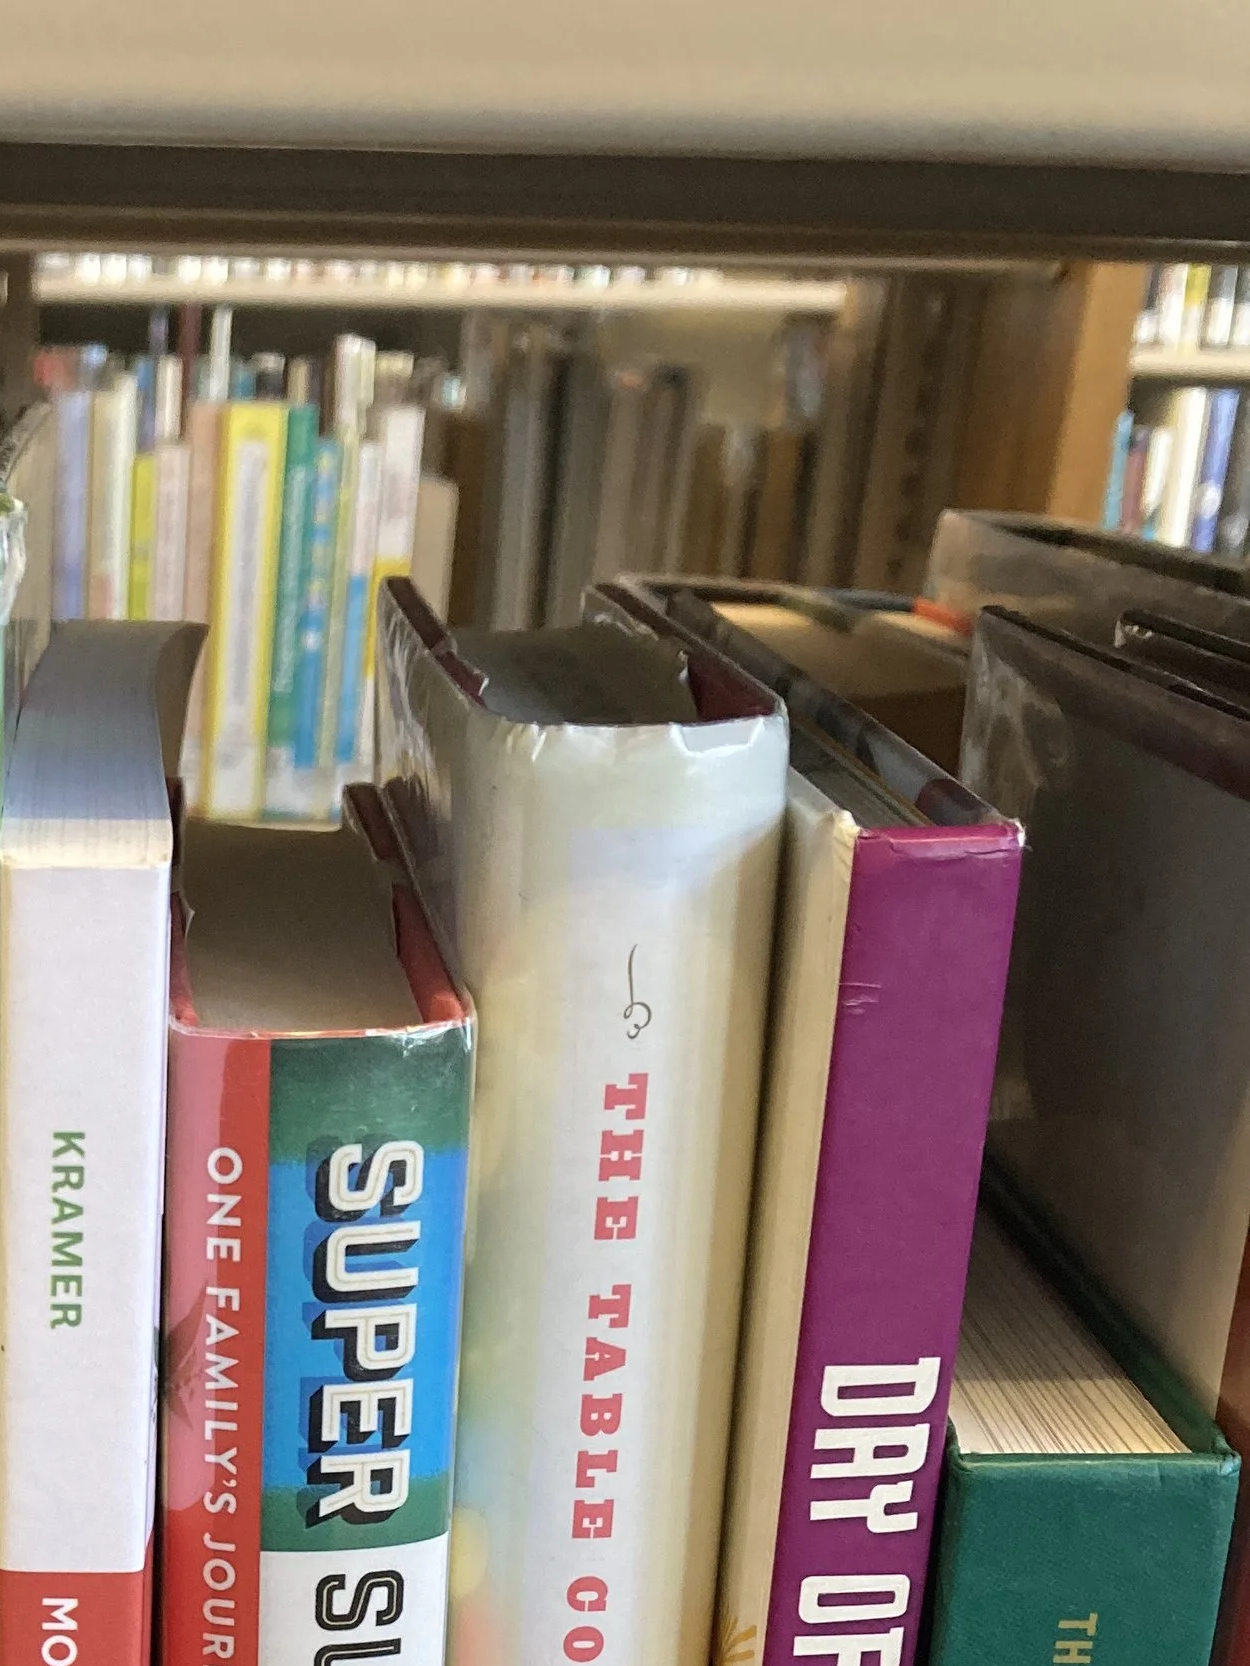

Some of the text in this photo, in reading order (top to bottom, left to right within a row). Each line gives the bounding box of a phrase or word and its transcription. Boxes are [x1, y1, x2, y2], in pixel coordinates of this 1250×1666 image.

[50, 1131, 86, 1329] KRAMER
[206, 1147, 243, 1263] ONE
[593, 1072, 649, 1241] THE
[203, 1286, 240, 1514] FAMILY'S
[316, 1140, 425, 1518] SUPER
[572, 1283, 632, 1539] TABLE
[810, 1356, 942, 1534] DAY
